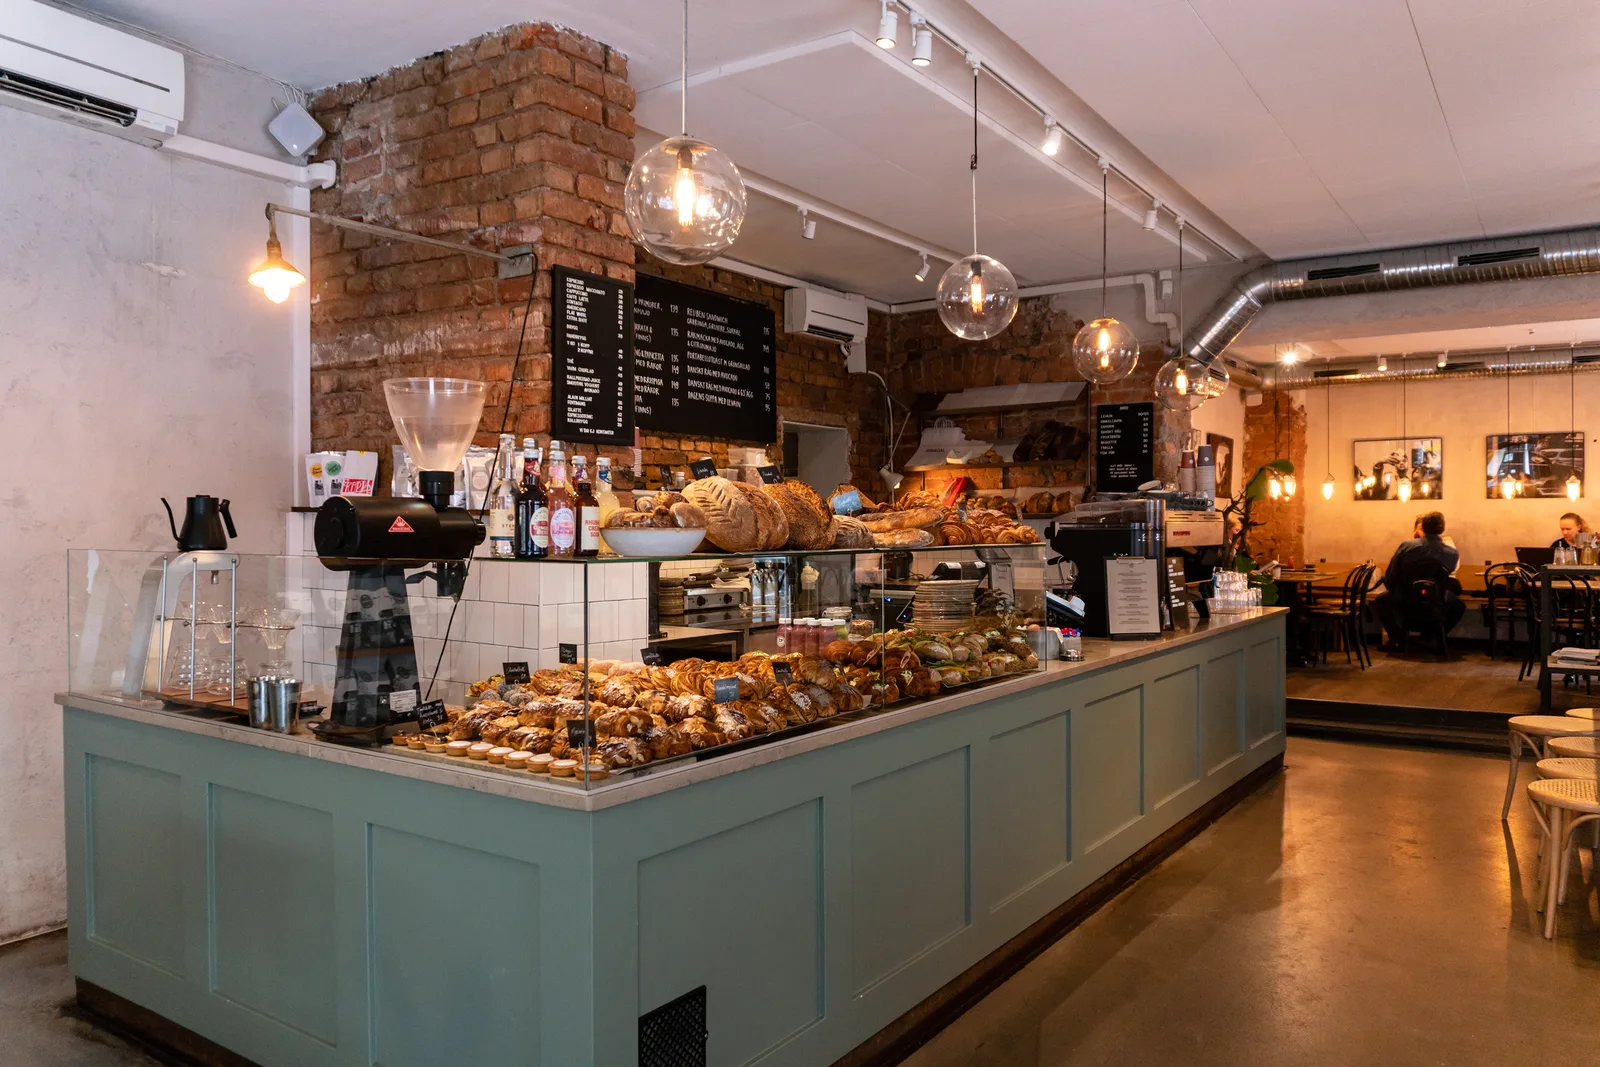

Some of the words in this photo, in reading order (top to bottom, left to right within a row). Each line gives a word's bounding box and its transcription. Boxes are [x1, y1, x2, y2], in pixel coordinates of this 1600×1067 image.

[687, 307, 705, 318] REUBEN
[706, 312, 728, 324] SANDWICH
[687, 391, 704, 401] DAGENS
